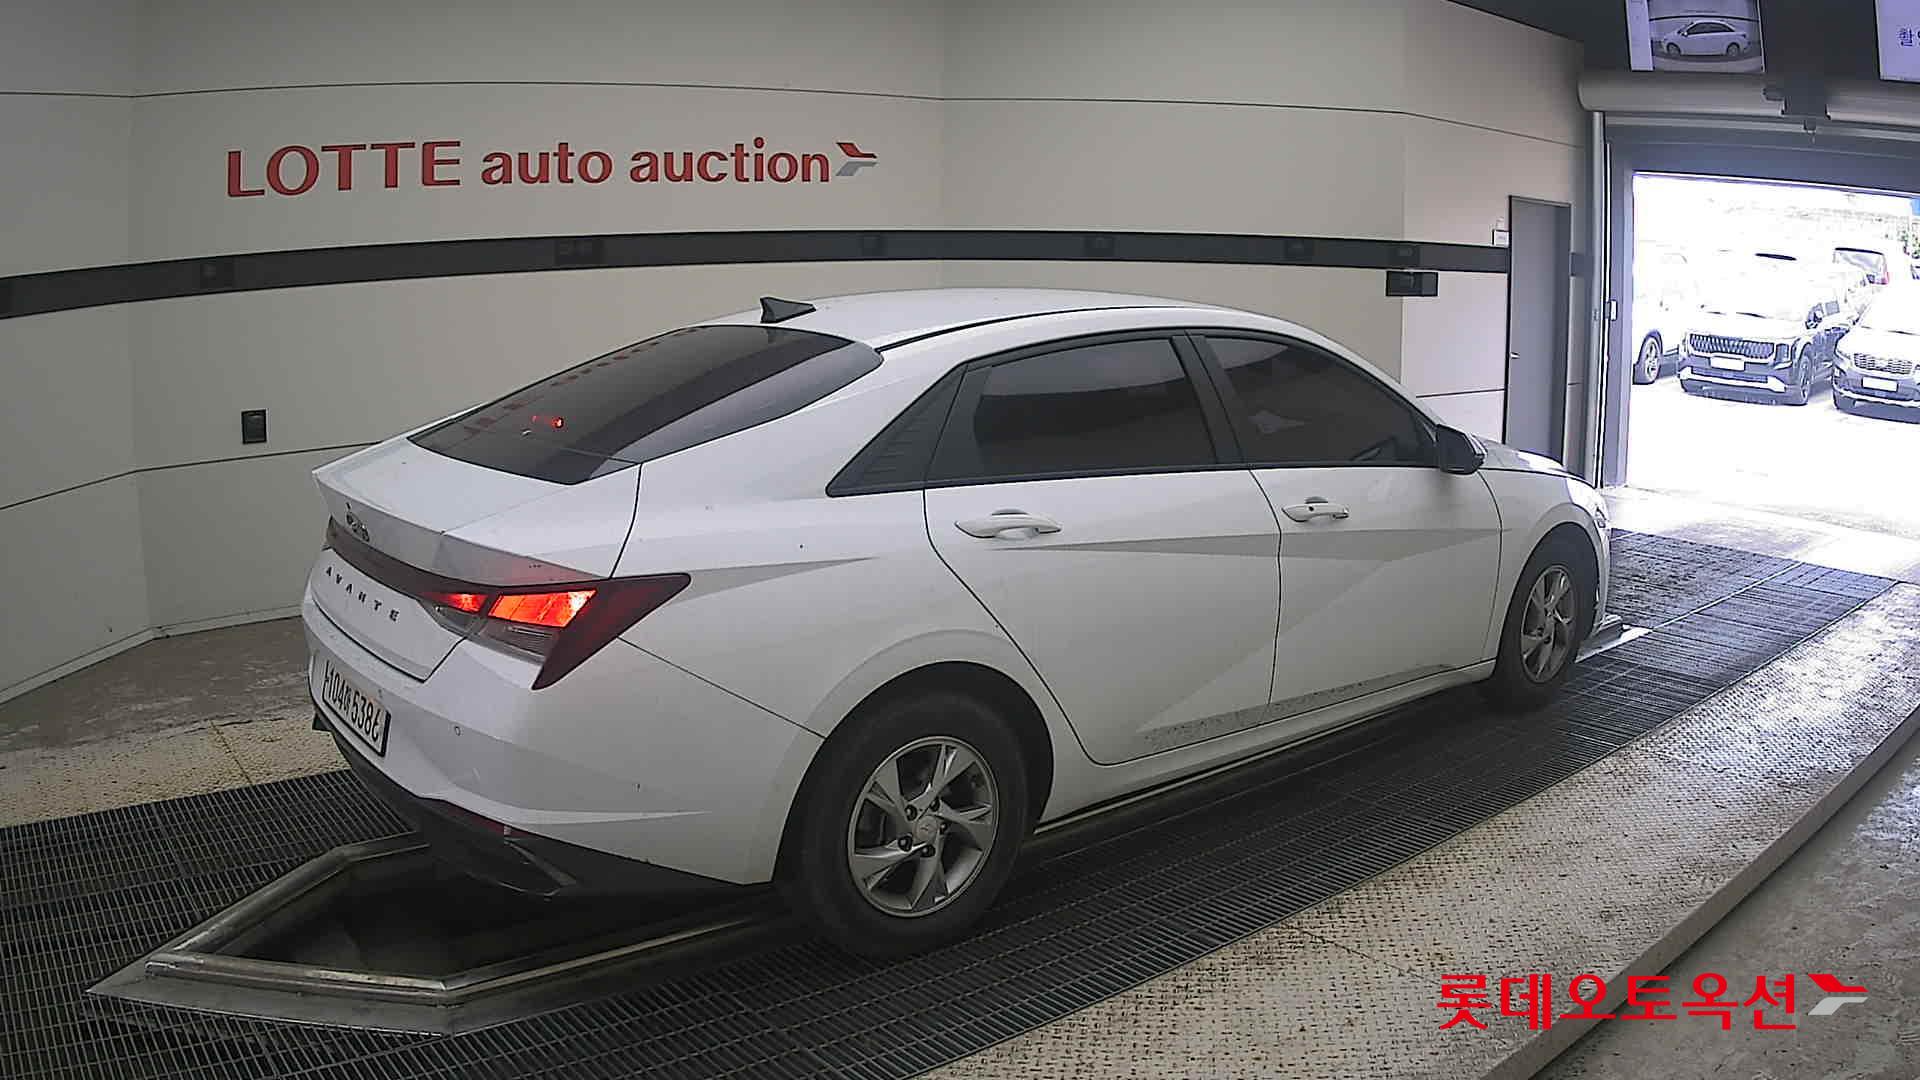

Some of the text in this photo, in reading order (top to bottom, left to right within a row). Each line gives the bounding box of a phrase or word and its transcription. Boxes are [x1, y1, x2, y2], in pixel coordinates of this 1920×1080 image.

[227, 136, 831, 198] LOTTE auto auction
[325, 566, 401, 623] AVANTE
